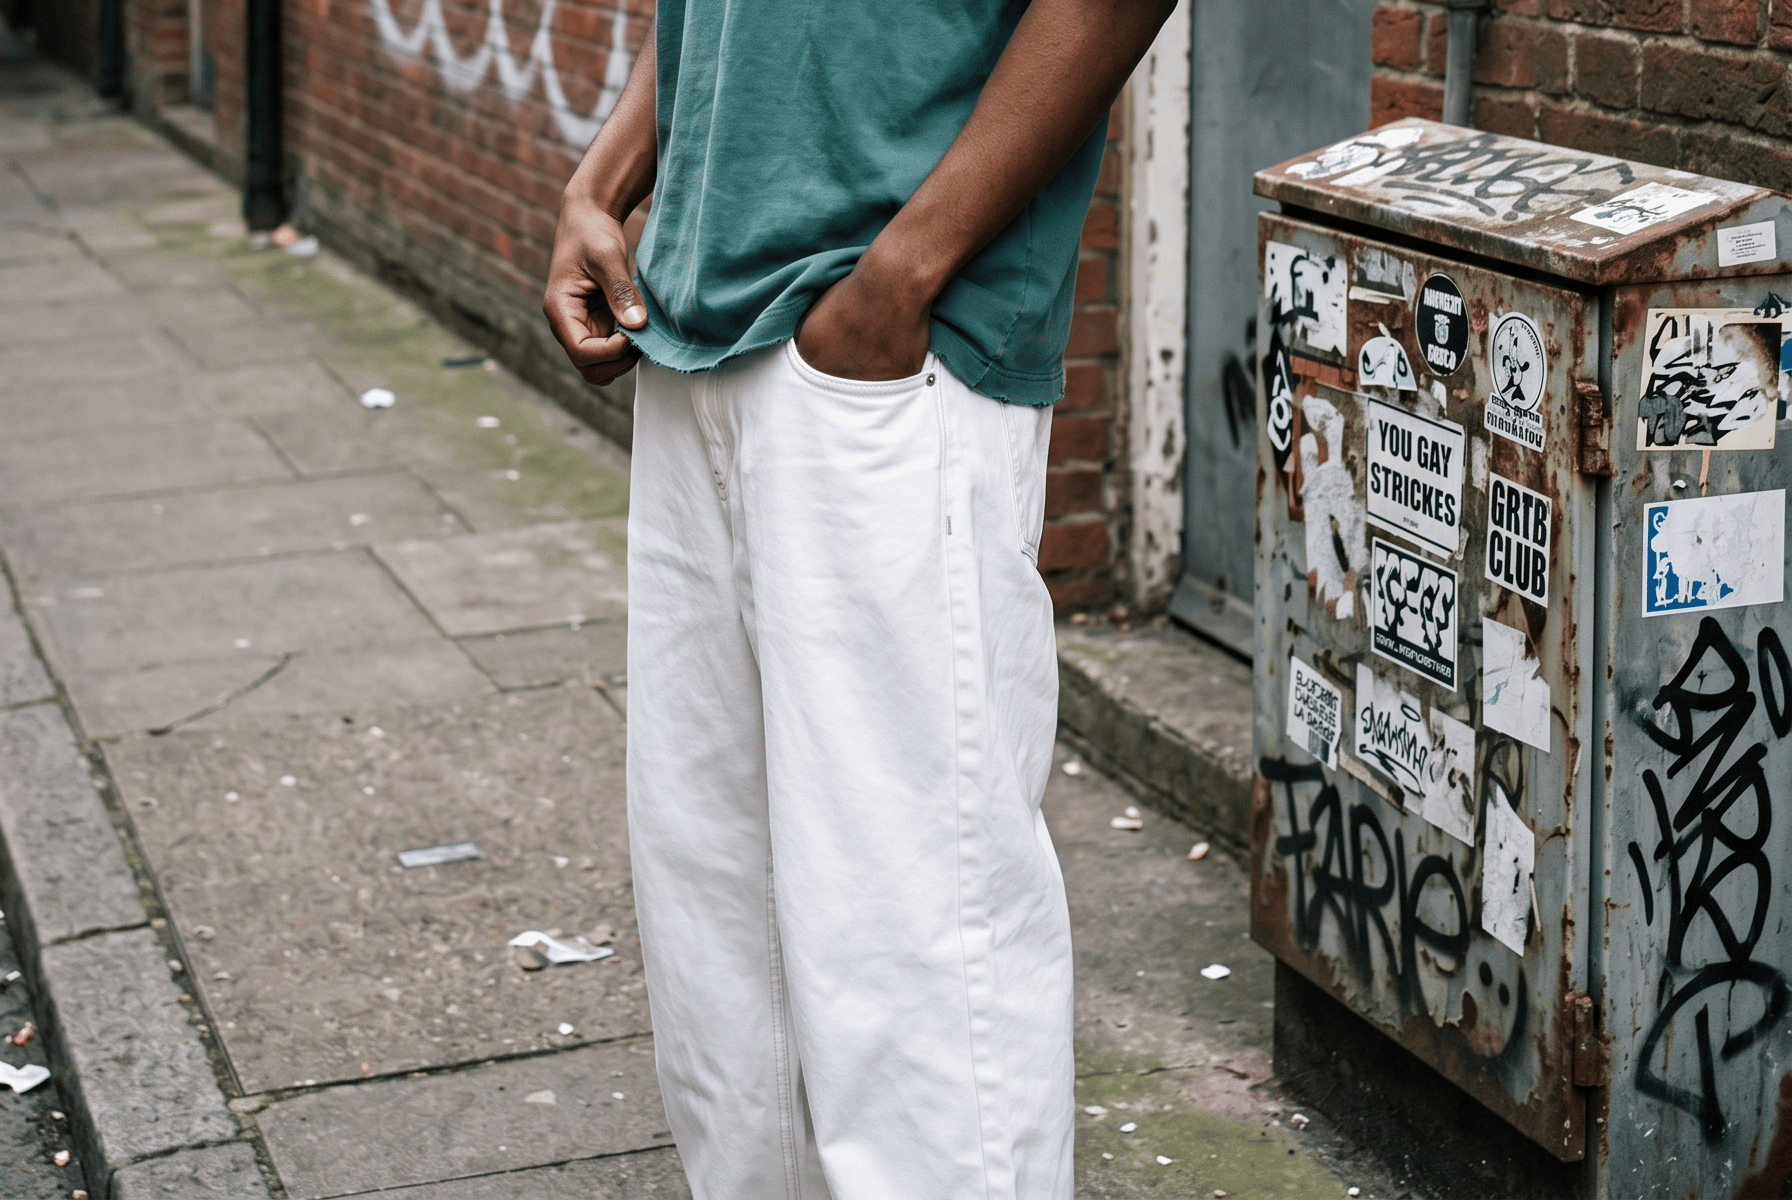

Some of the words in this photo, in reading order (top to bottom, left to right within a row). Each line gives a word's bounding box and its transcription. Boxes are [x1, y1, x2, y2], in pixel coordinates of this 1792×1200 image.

[1378, 418, 1412, 463] YOU
[1417, 435, 1453, 479] GAY
[1370, 461, 1456, 527] STRICKES
[1491, 479, 1548, 548] GRTB
[1489, 529, 1547, 598] CLUB
